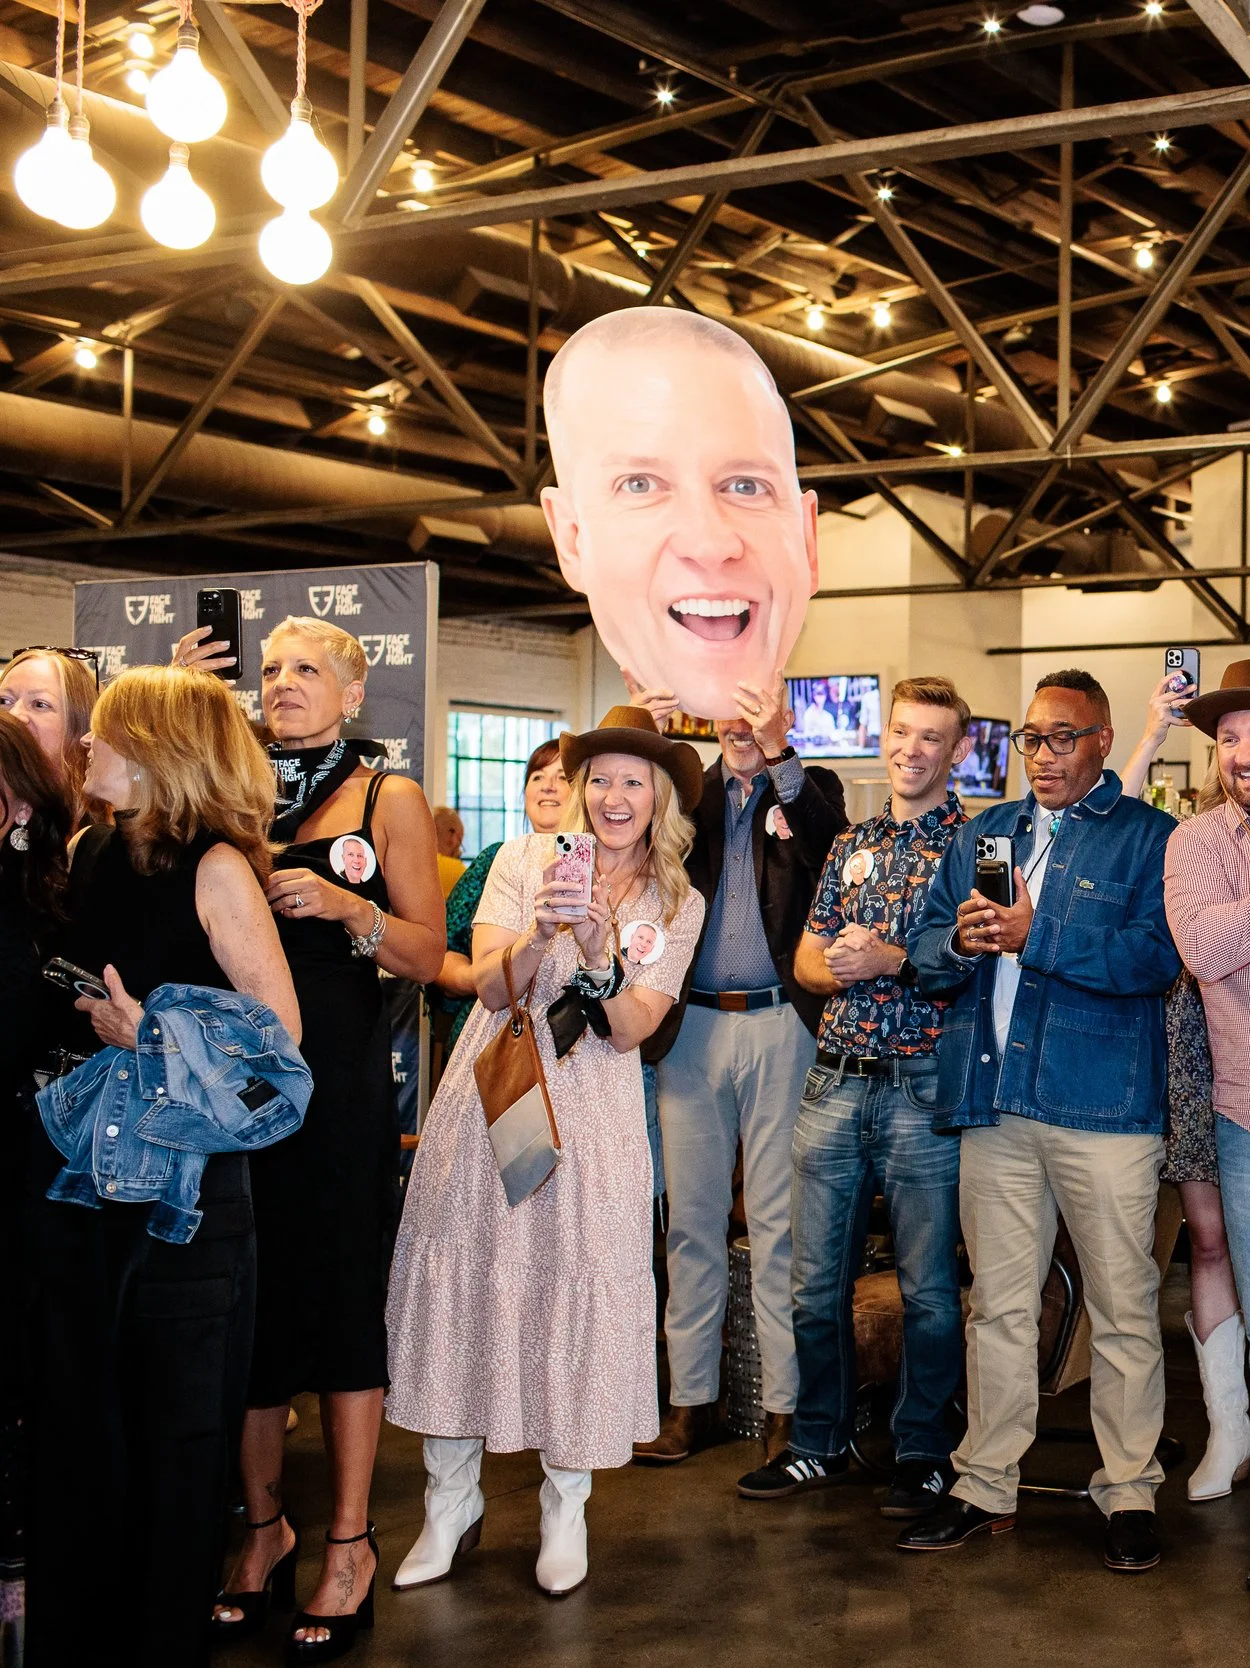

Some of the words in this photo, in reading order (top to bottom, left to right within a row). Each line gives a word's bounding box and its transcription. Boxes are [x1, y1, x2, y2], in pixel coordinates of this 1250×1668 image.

[335, 603, 363, 616] FIGHT
[149, 612, 176, 625] FIGHT
[385, 653, 414, 666] FIGHT
[278, 758, 301, 768] FACE
[383, 757, 411, 770] FIGHT
[279, 766, 297, 775] THE
